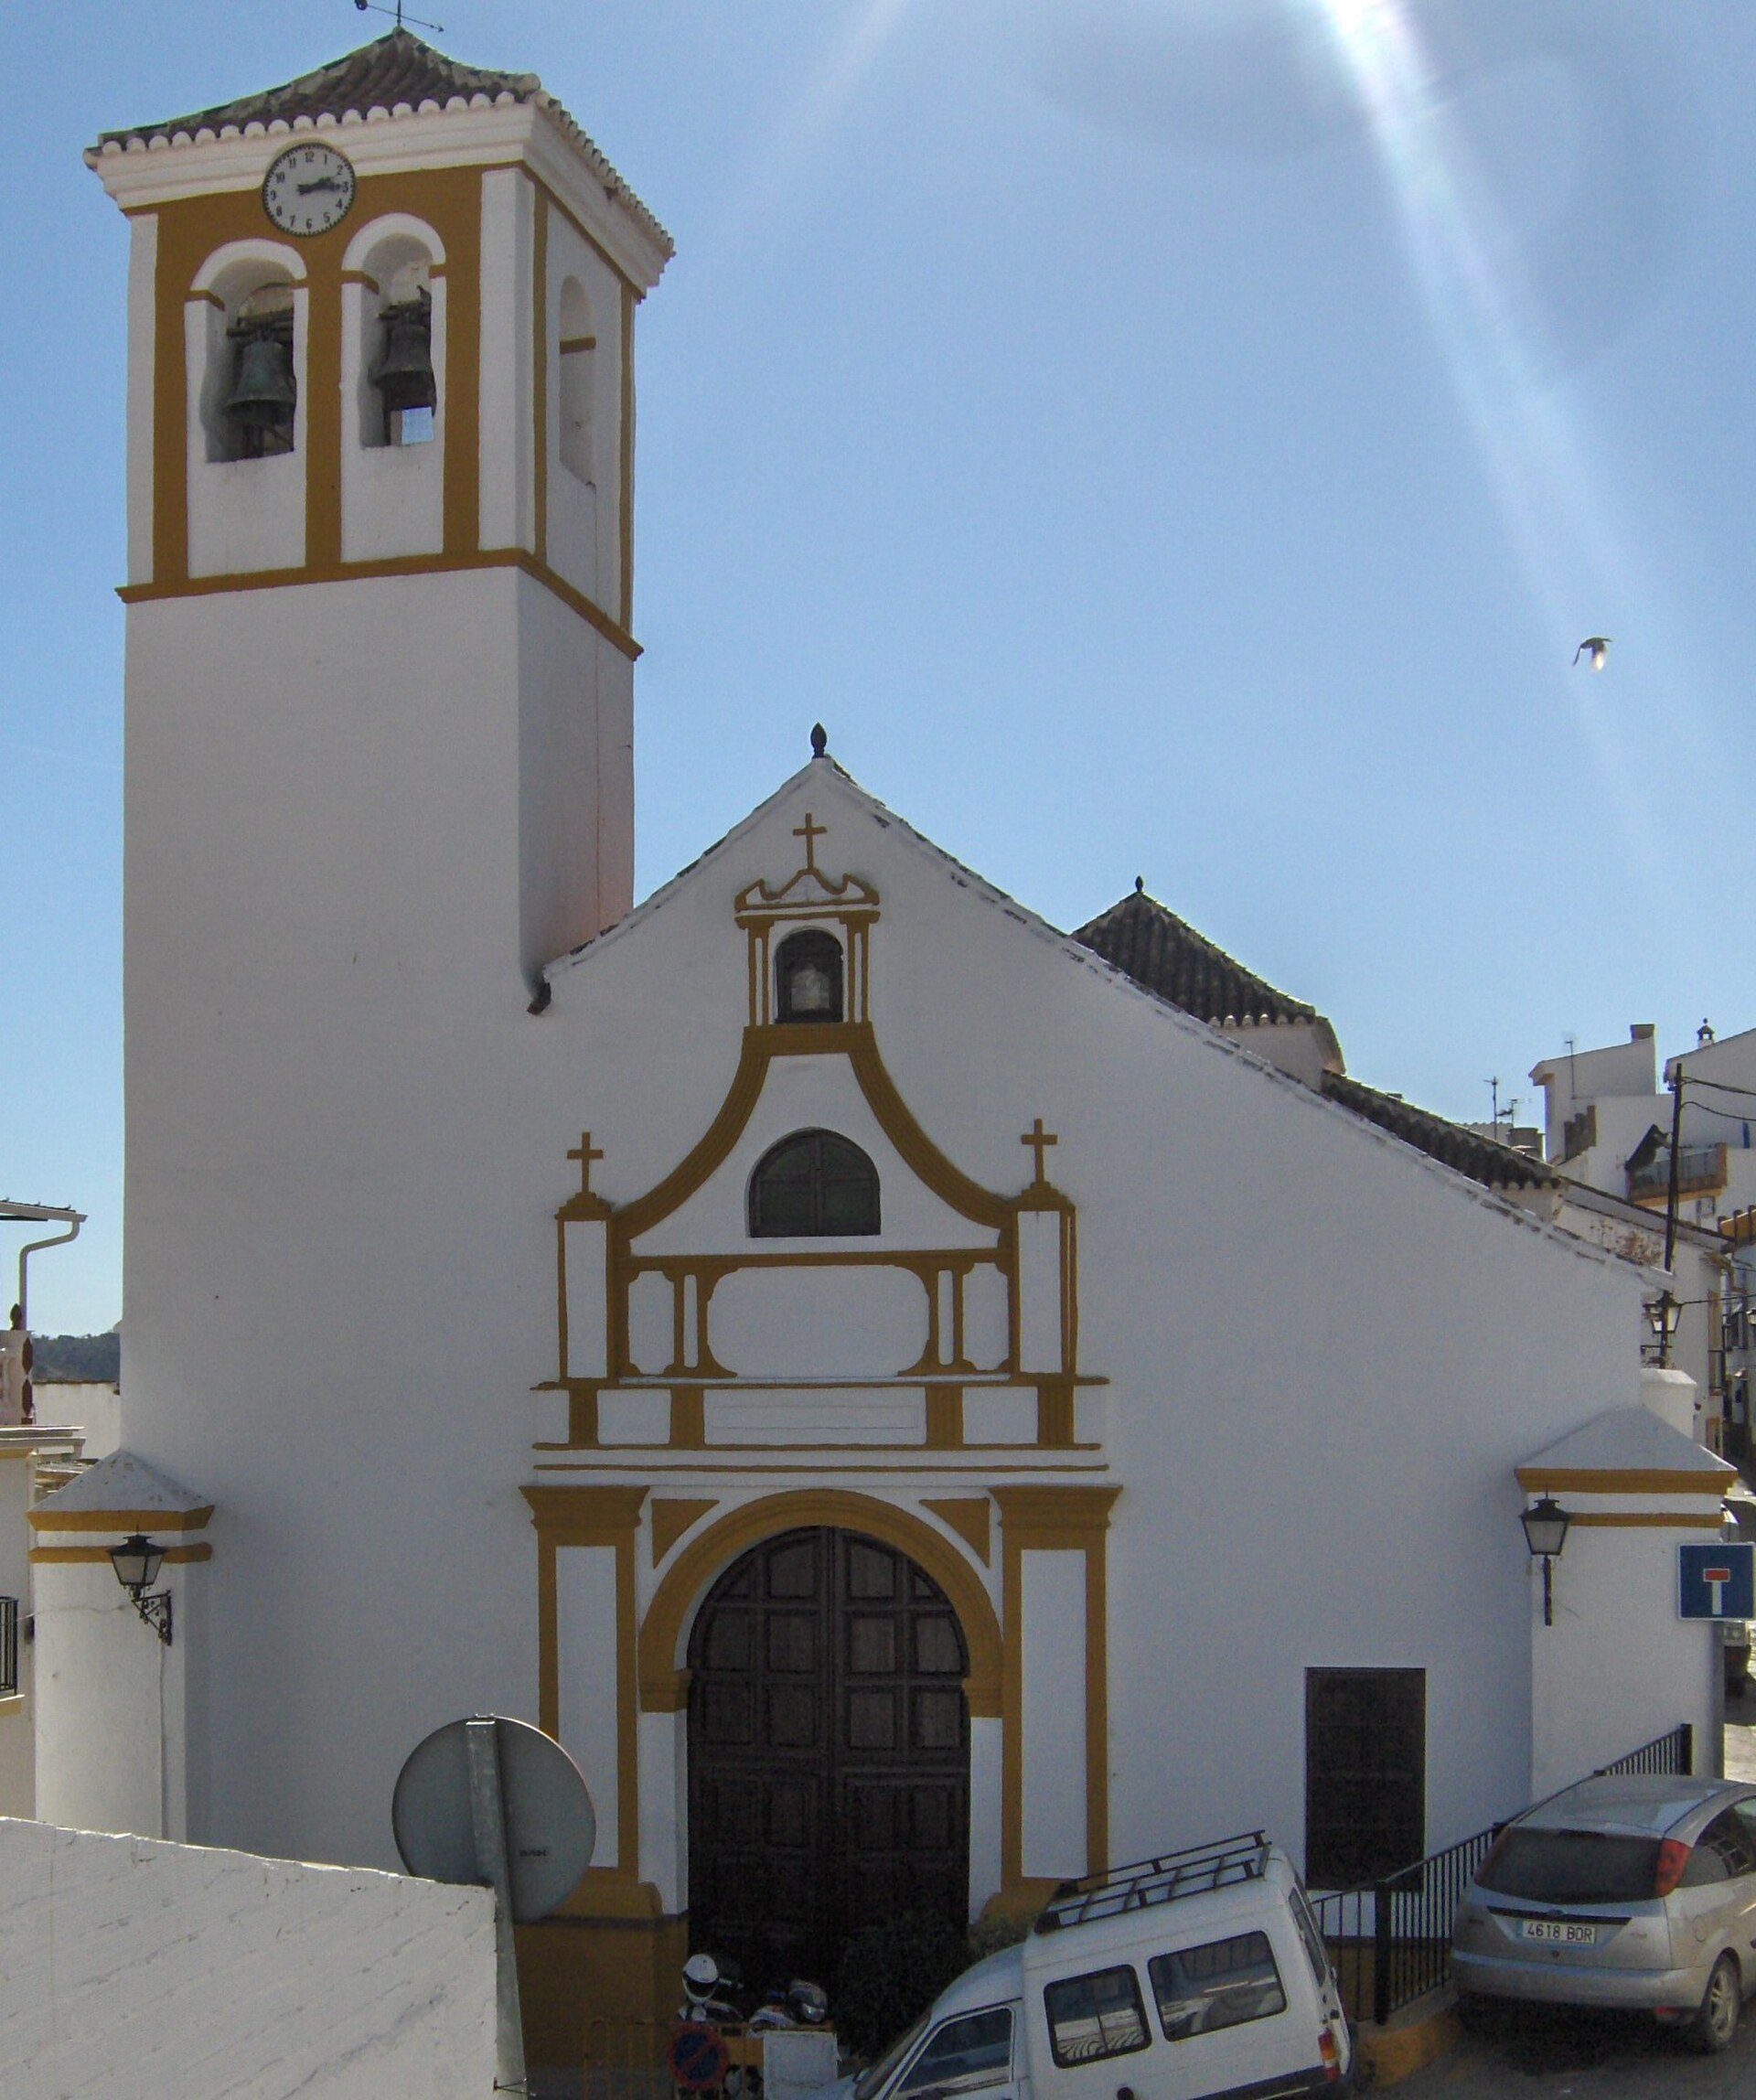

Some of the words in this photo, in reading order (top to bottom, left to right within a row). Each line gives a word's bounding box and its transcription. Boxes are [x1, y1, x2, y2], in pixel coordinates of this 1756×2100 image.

[305, 151, 314, 162] 12
[324, 154, 327, 164] 1
[288, 157, 296, 168] 11
[337, 165, 343, 175] 2
[275, 172, 284, 183] 10
[342, 182, 348, 192] 3
[271, 190, 276, 200] 9
[336, 198, 342, 209] 4
[276, 206, 282, 216] 8
[290, 215, 295, 227] 7
[324, 212, 330, 222] 5
[306, 219, 312, 229] 6
[1527, 1923, 1560, 1939] 4618
